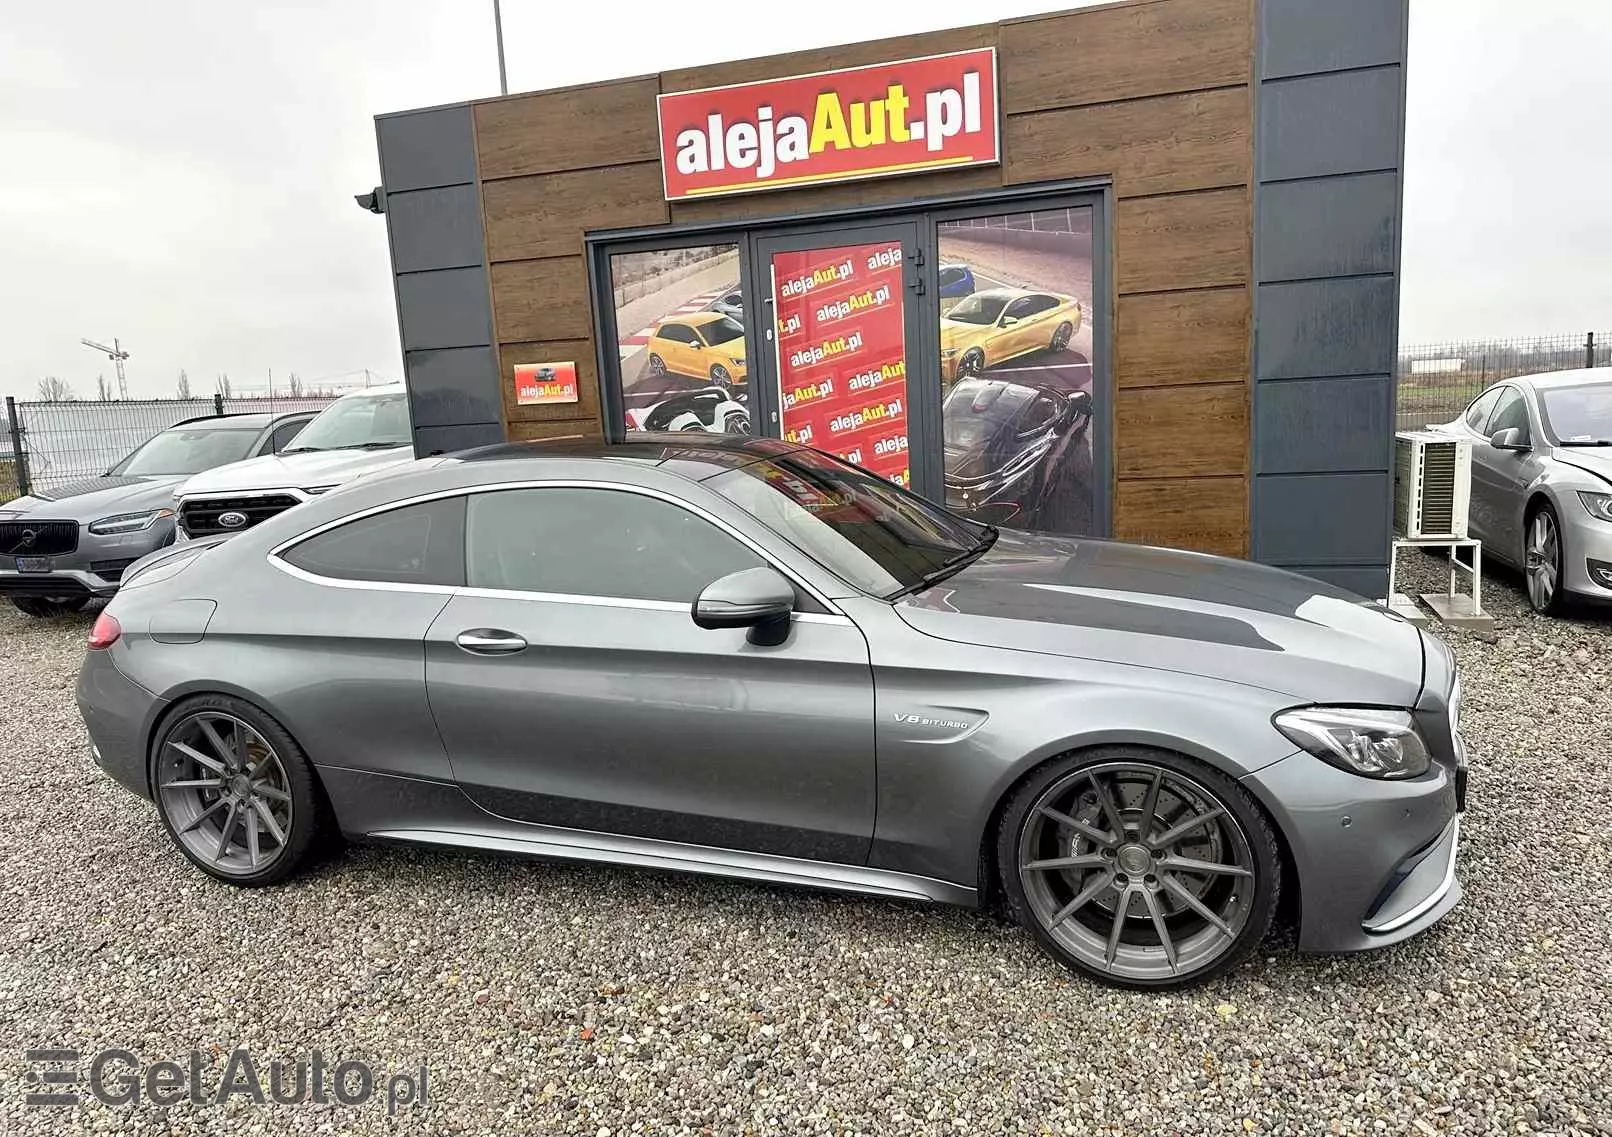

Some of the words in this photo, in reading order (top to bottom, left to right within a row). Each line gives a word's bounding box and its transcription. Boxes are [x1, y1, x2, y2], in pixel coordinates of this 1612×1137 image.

[676, 71, 981, 178] alejaAut.pl
[781, 259, 854, 297] alejaAut.pl
[816, 284, 891, 322] alejaAut.pl
[790, 331, 863, 367] alejaAut.pl
[520, 383, 574, 398] alejaAut.pl
[829, 398, 903, 432] alejaAut.pl
[894, 712, 920, 724] V8
